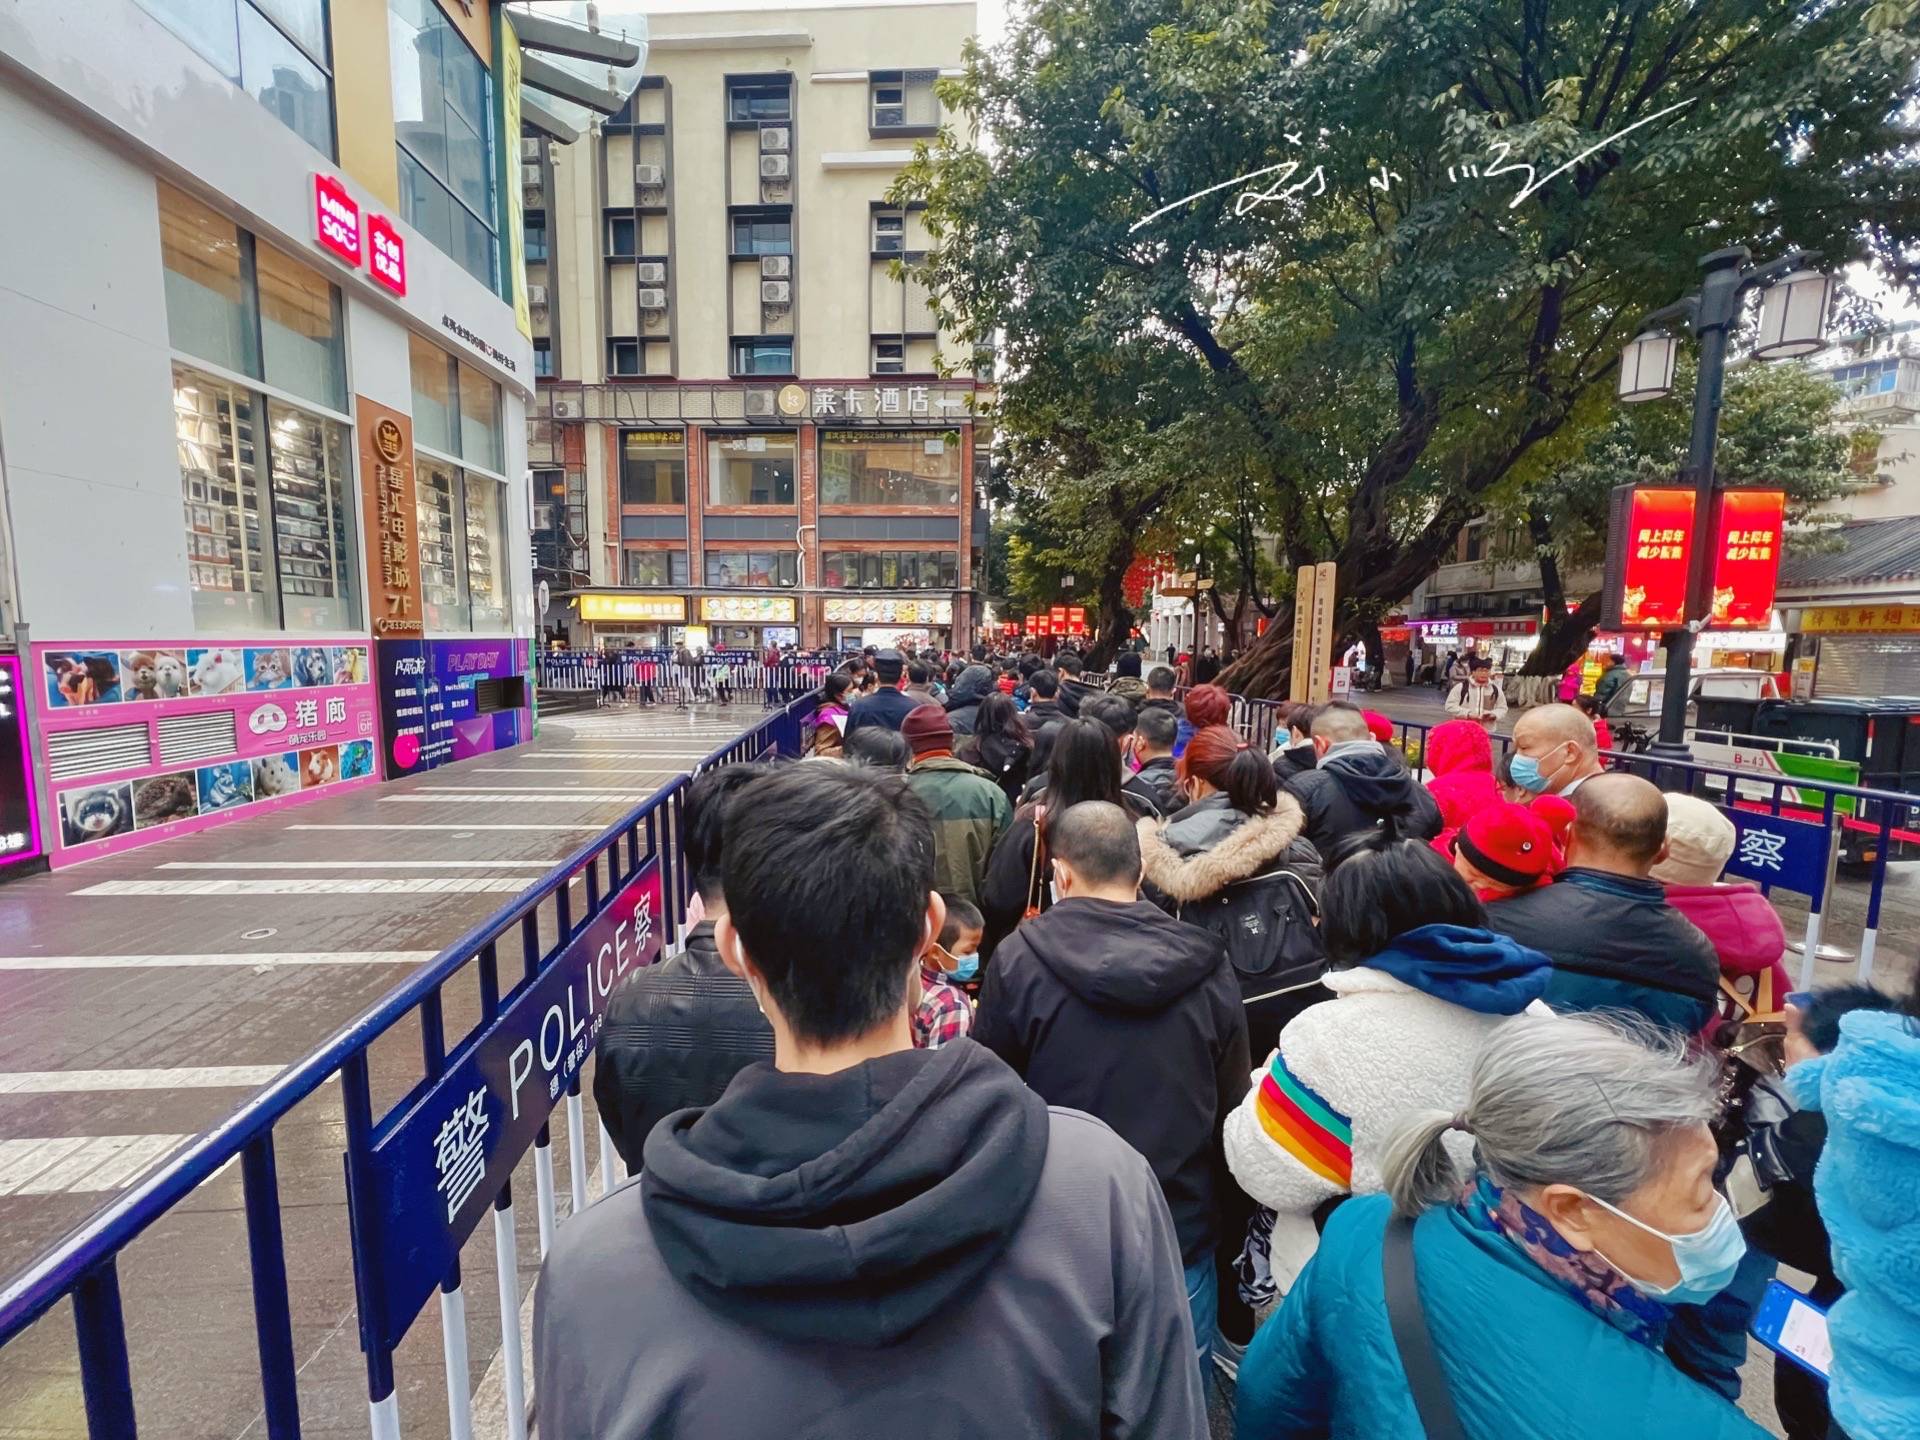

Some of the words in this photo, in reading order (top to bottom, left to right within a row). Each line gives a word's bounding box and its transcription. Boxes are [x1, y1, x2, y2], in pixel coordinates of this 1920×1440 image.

[320, 190, 356, 230] MINI
[374, 231, 399, 262] 名创
[375, 252, 401, 283] 优品
[813, 386, 929, 415] 莱卡酒店
[388, 466, 411, 588] 星汇电影城
[1637, 529, 1685, 543] 网上拜年
[1727, 530, 1774, 544] 网上拜年
[384, 594, 412, 614] 7F
[546, 658, 570, 666] POLICE
[628, 656, 652, 664] POLICE
[711, 657, 736, 665] POLICE
[795, 658, 820, 666] POLICE
[295, 697, 346, 728] 猪廊
[1734, 752, 1765, 768] B-43
[1739, 828, 1787, 872] 察
[433, 1083, 490, 1226] 警
[508, 919, 629, 1121] POLICE
[633, 889, 653, 954] 察
